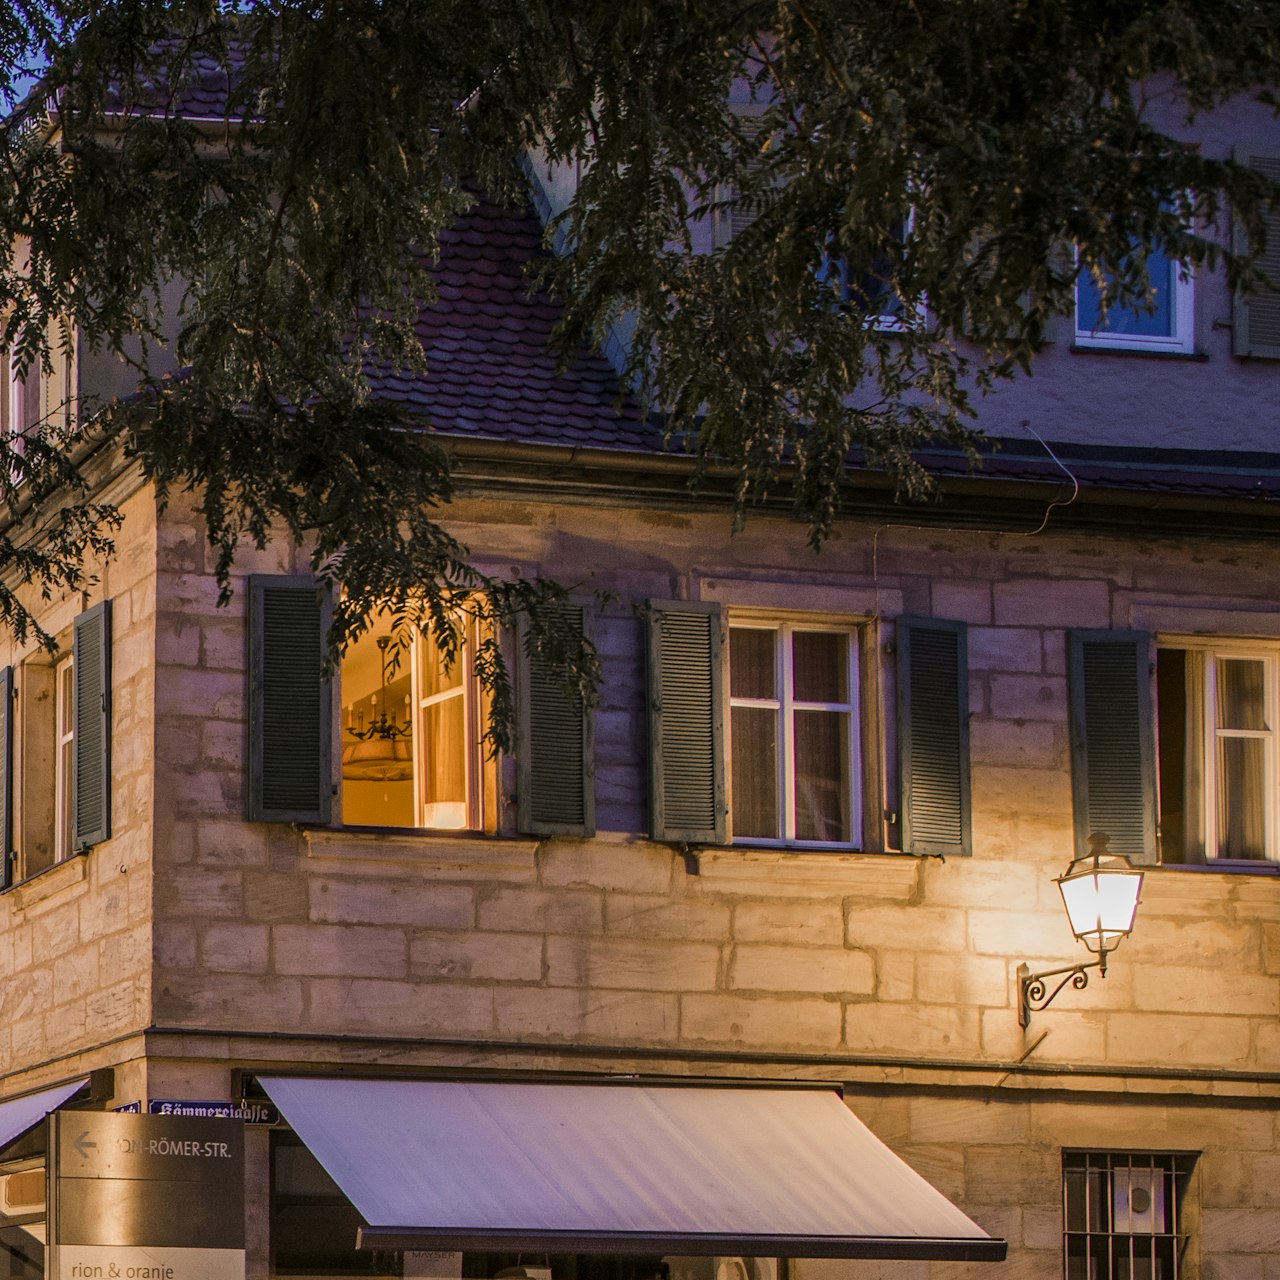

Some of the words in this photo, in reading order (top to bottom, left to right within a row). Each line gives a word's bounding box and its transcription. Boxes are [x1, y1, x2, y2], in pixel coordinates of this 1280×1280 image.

[117, 1137, 233, 1158] ON-RÖMER-STR.
[72, 1263, 103, 1278] rion
[108, 1262, 121, 1278] &
